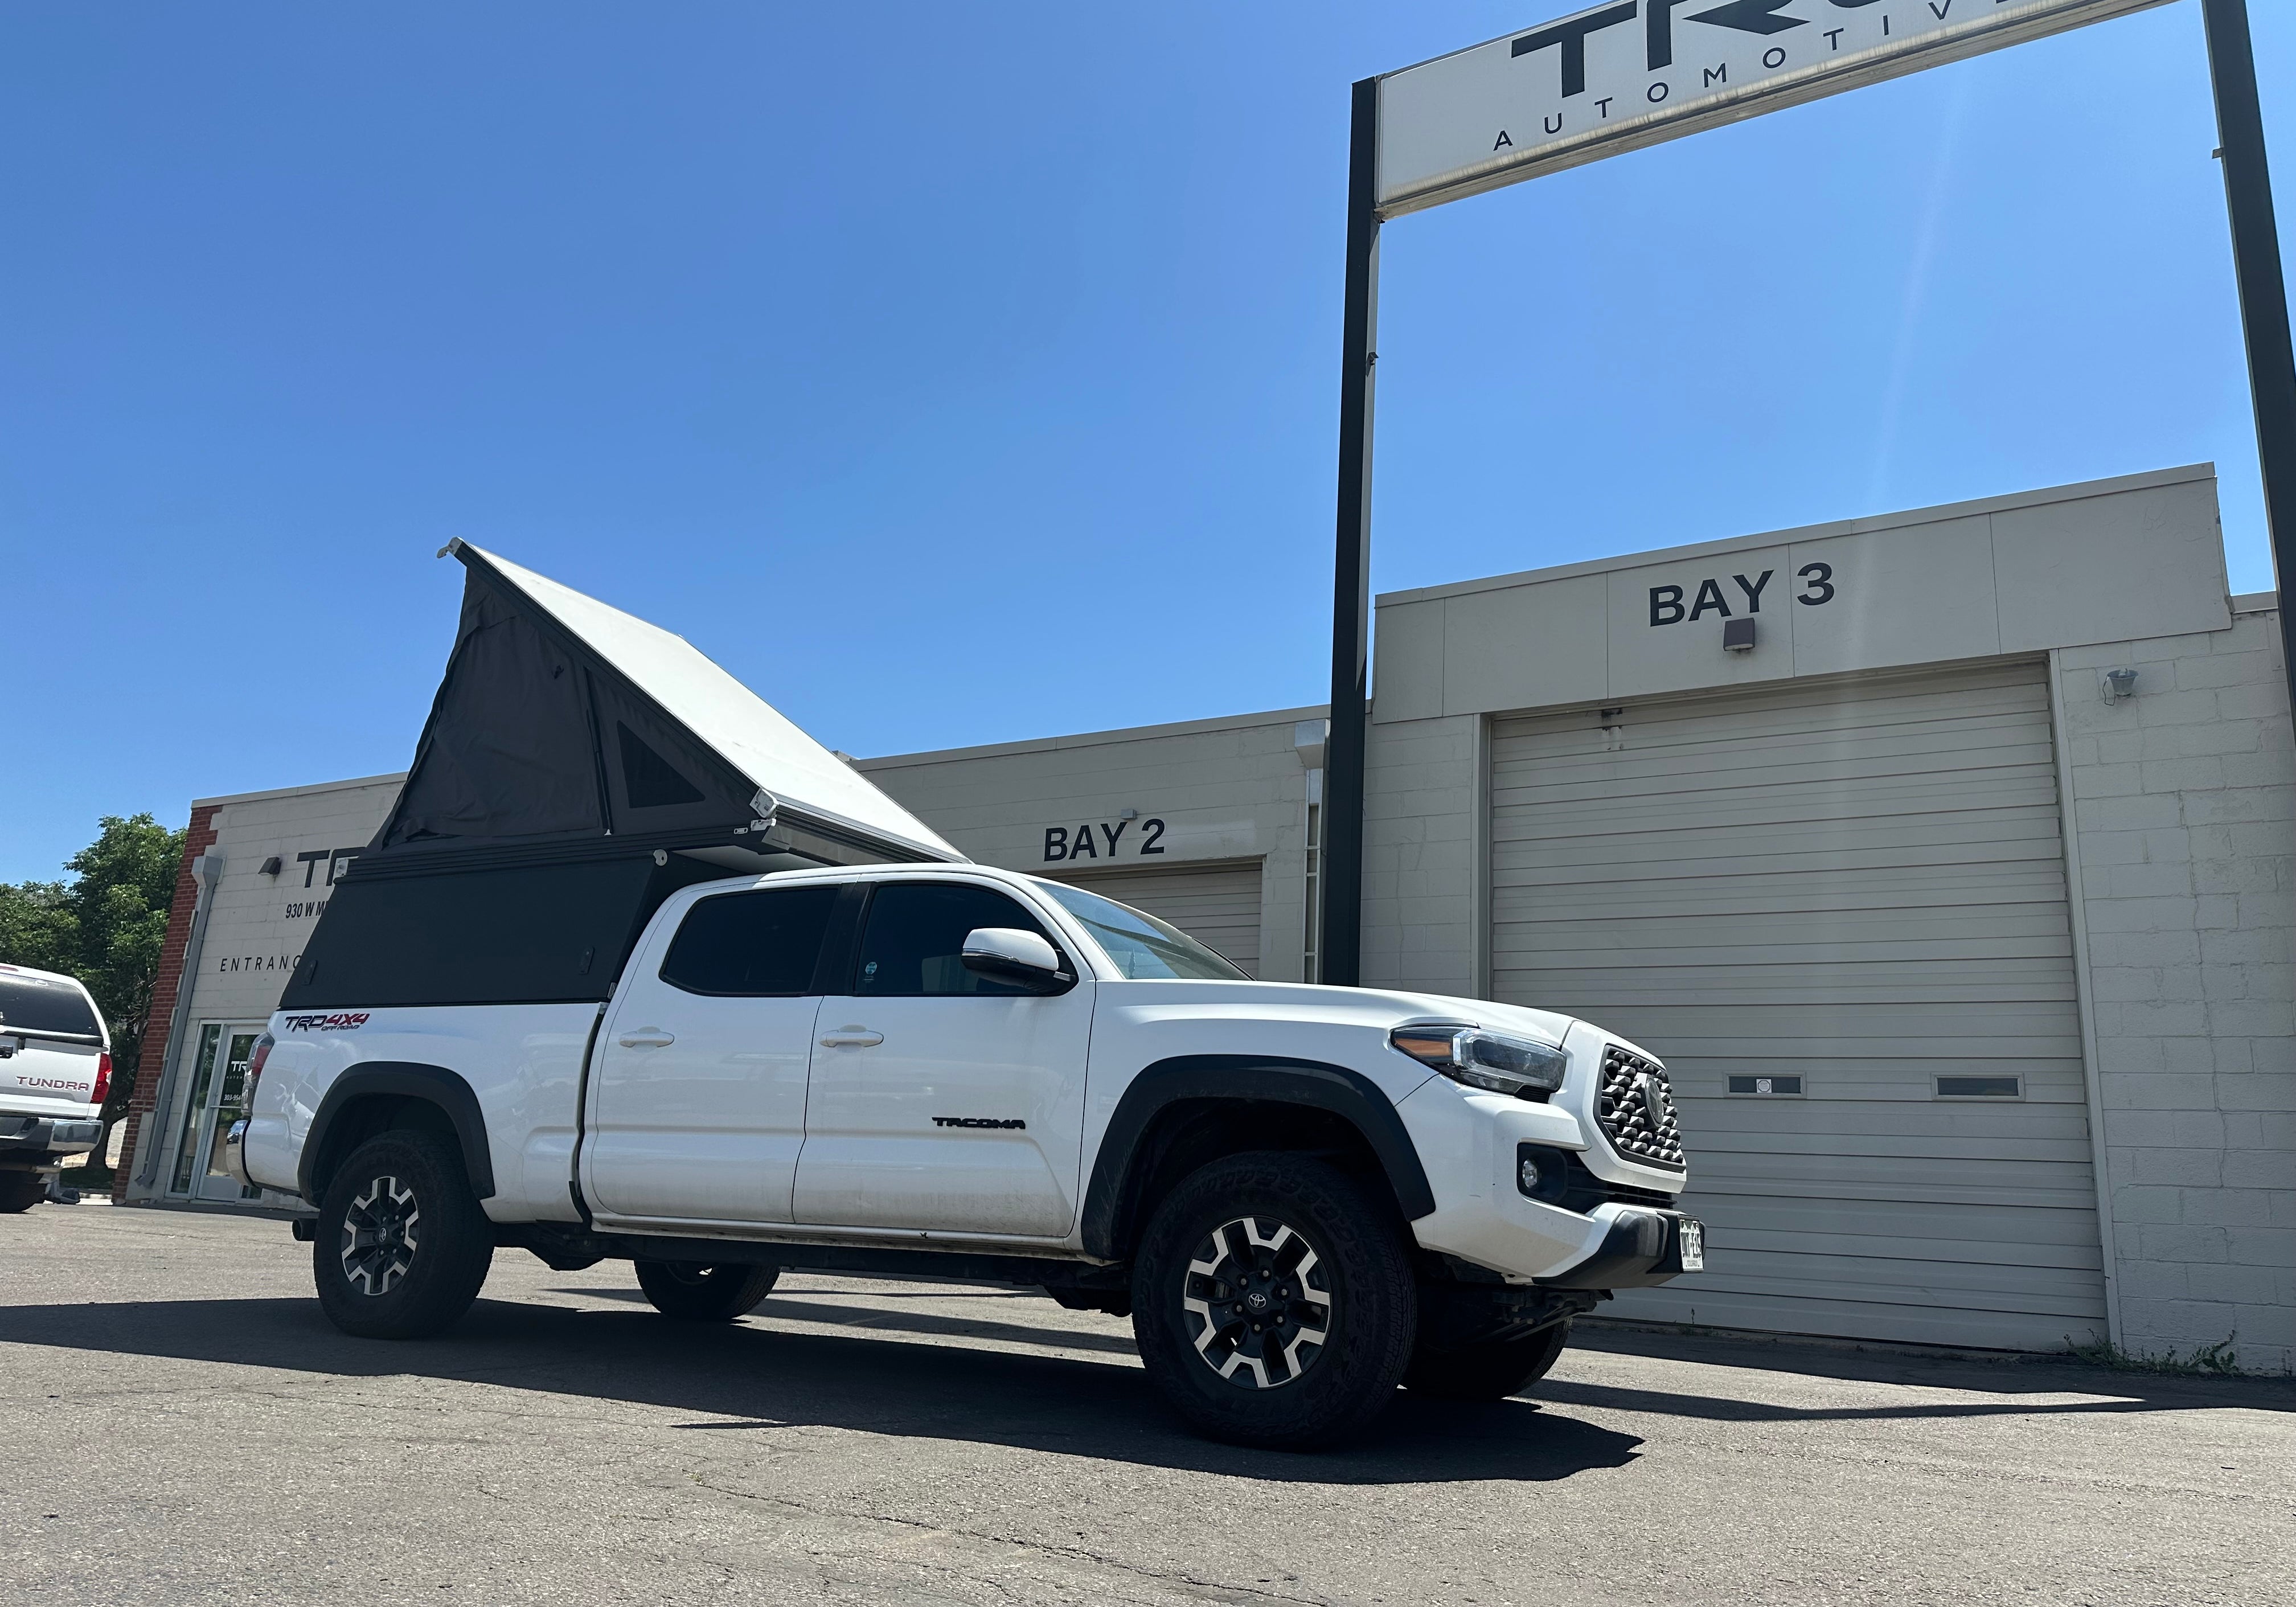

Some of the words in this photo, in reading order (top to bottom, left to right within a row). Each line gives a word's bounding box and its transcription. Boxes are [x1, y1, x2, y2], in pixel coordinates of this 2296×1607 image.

[1493, 0, 2009, 151] AUTOMOTIV
[1649, 569, 1775, 627] BAY
[1797, 562, 1835, 606] 3
[1044, 821, 1128, 862] BAY
[1140, 818, 1165, 855] 2
[285, 903, 303, 919] 930
[305, 901, 315, 917] W
[315, 900, 328, 916] M
[16, 1076, 90, 1092] TUNDRA
[932, 1117, 1026, 1130] TACOMA
